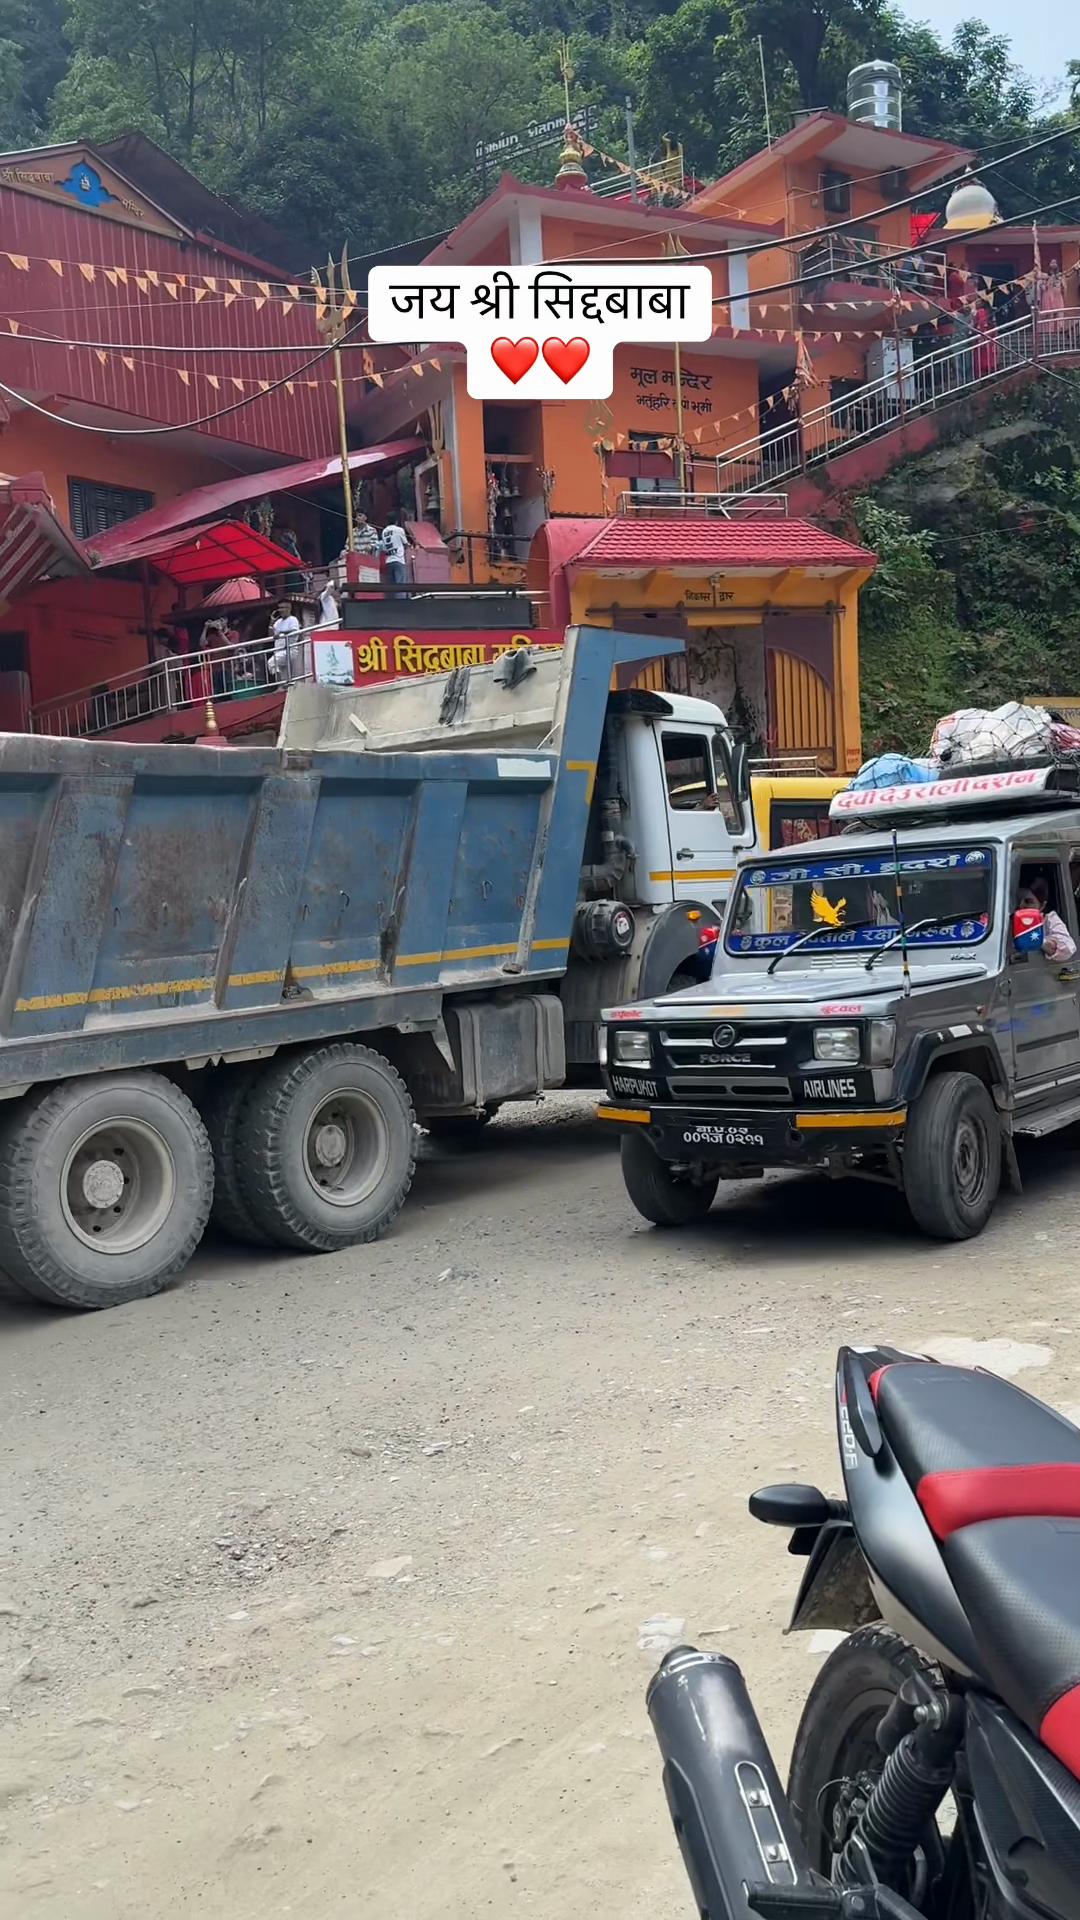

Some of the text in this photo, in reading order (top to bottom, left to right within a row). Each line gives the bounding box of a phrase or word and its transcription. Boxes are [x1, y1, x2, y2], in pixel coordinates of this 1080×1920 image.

[630, 367, 658, 388] मूल
[357, 635, 388, 673] श्री
[700, 1053, 752, 1064] FORCE
[803, 1078, 857, 1099] AIRLINES
